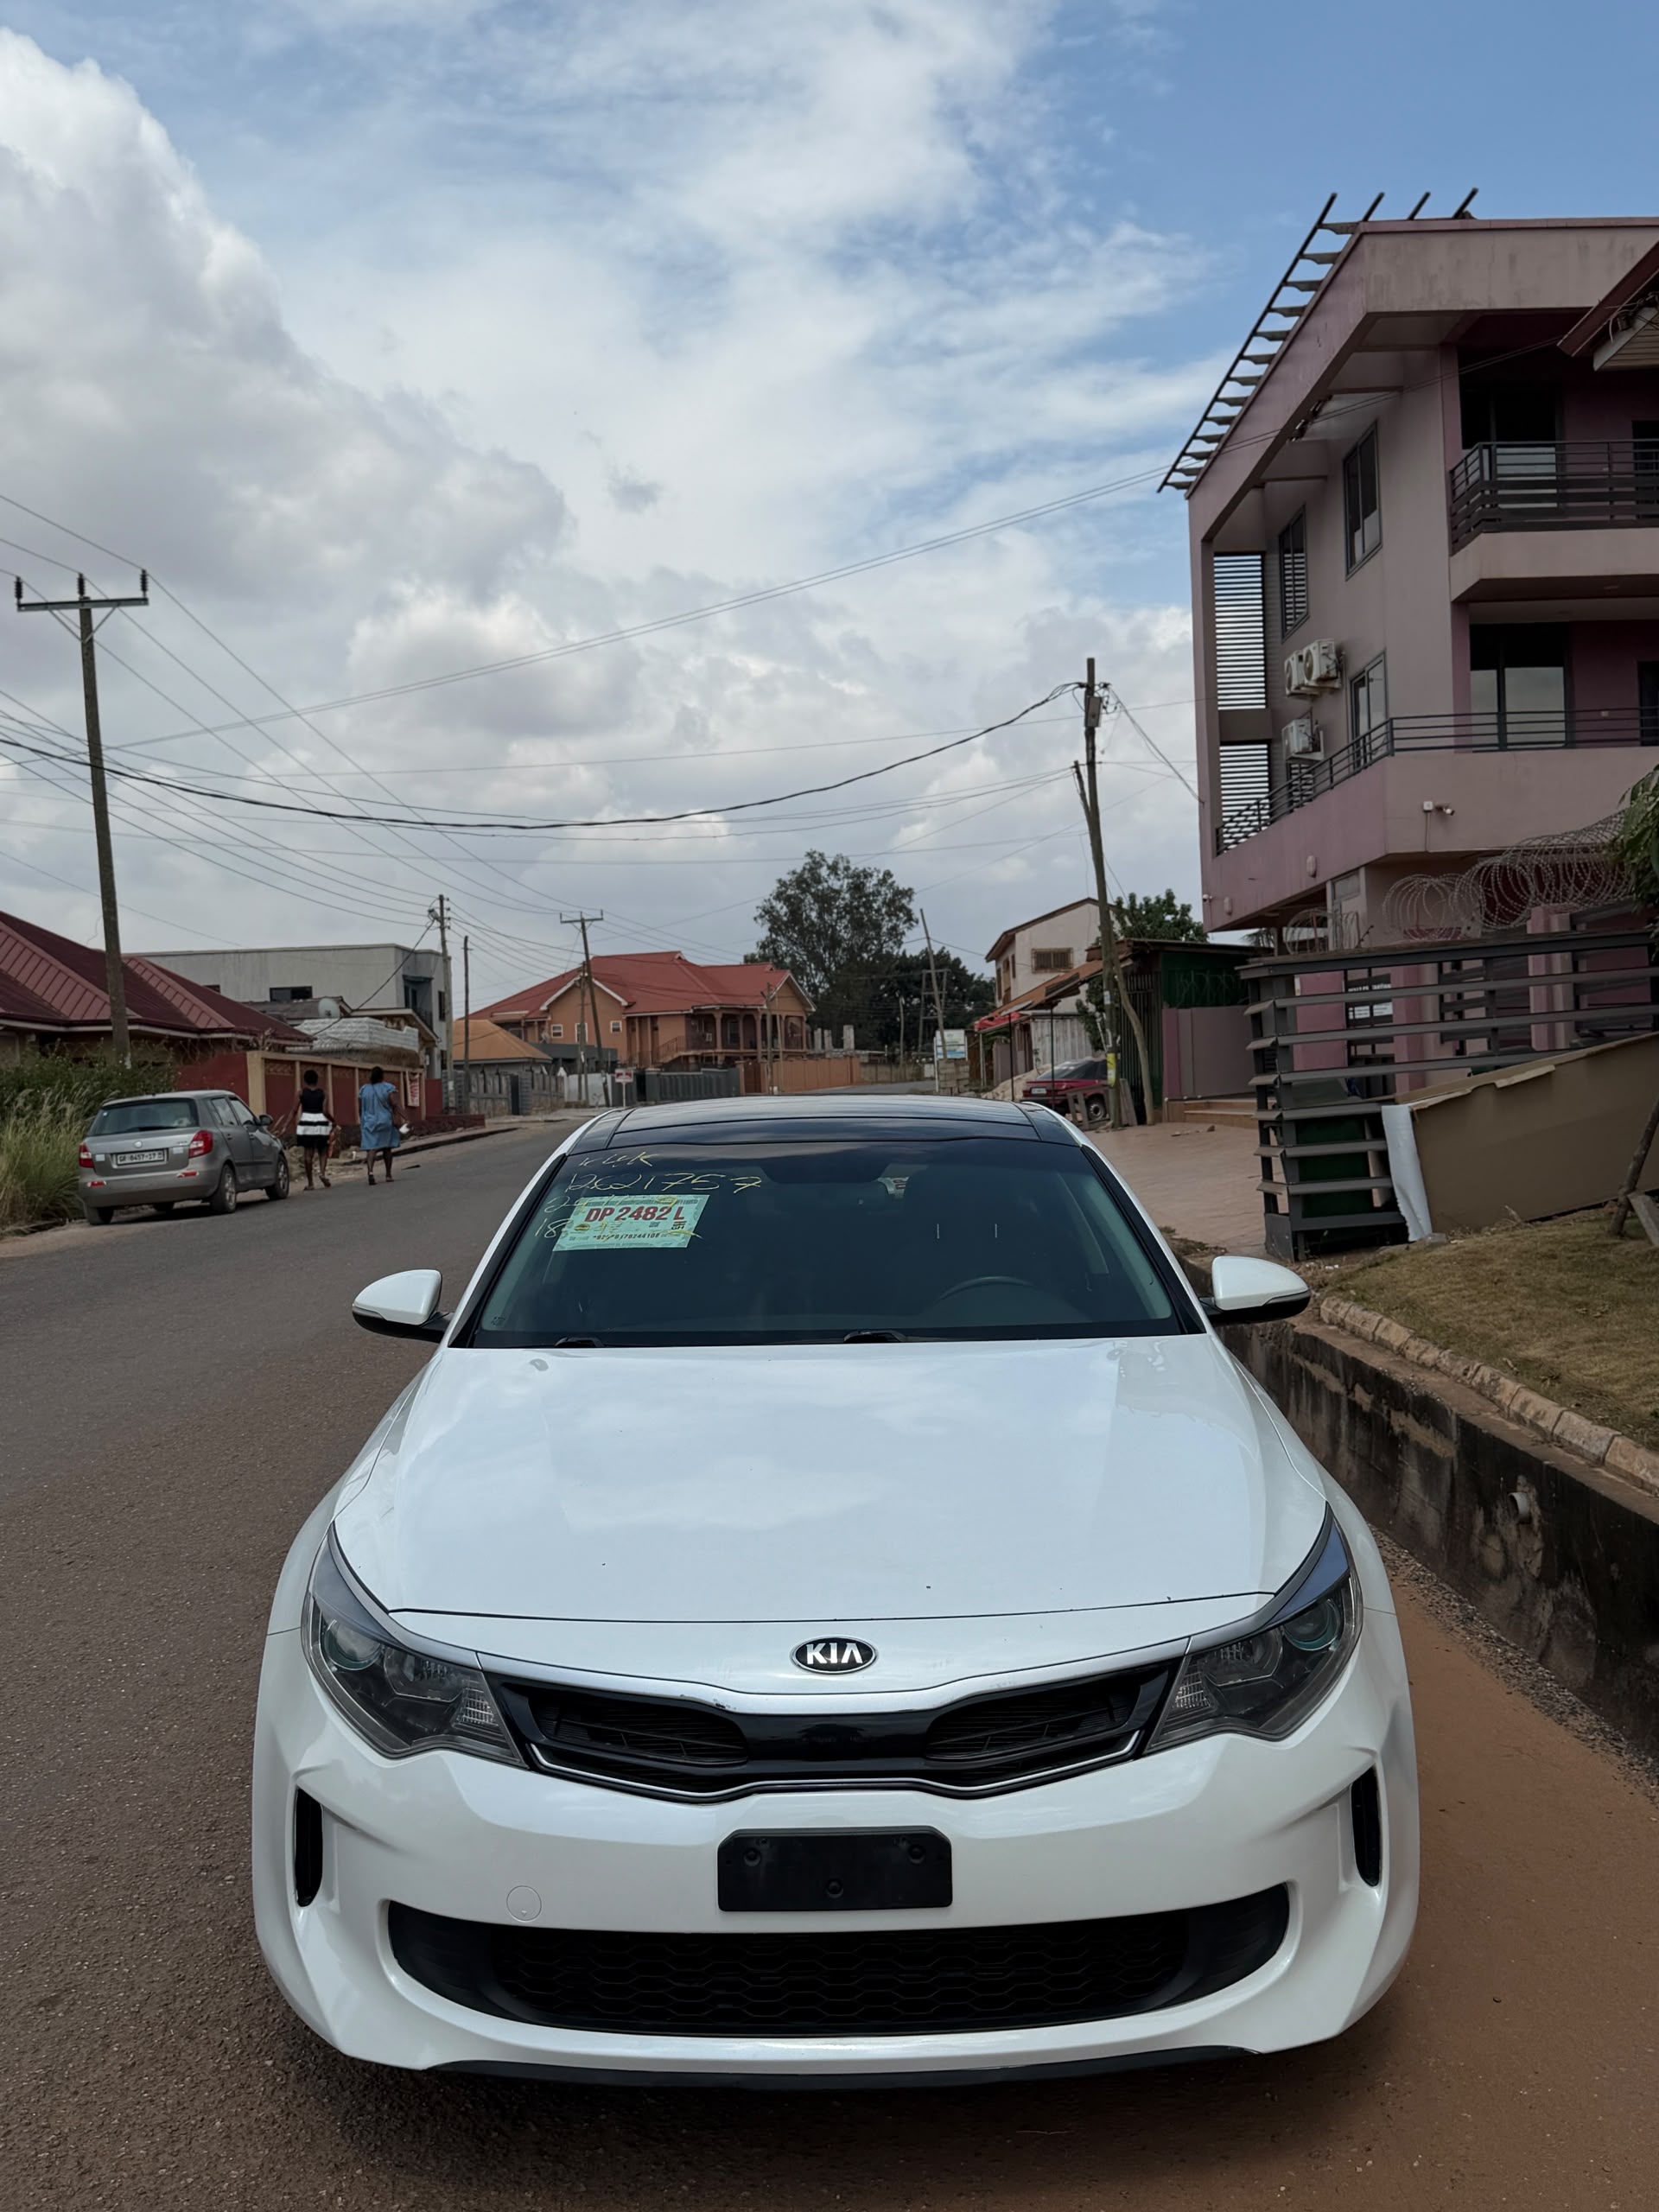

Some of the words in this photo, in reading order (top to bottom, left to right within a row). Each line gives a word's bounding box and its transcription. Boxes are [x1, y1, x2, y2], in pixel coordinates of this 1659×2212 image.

[585, 1207, 615, 1222] DP
[613, 1206, 671, 1221] 2482
[672, 1206, 685, 1220] L
[806, 1643, 863, 1664] KIA
